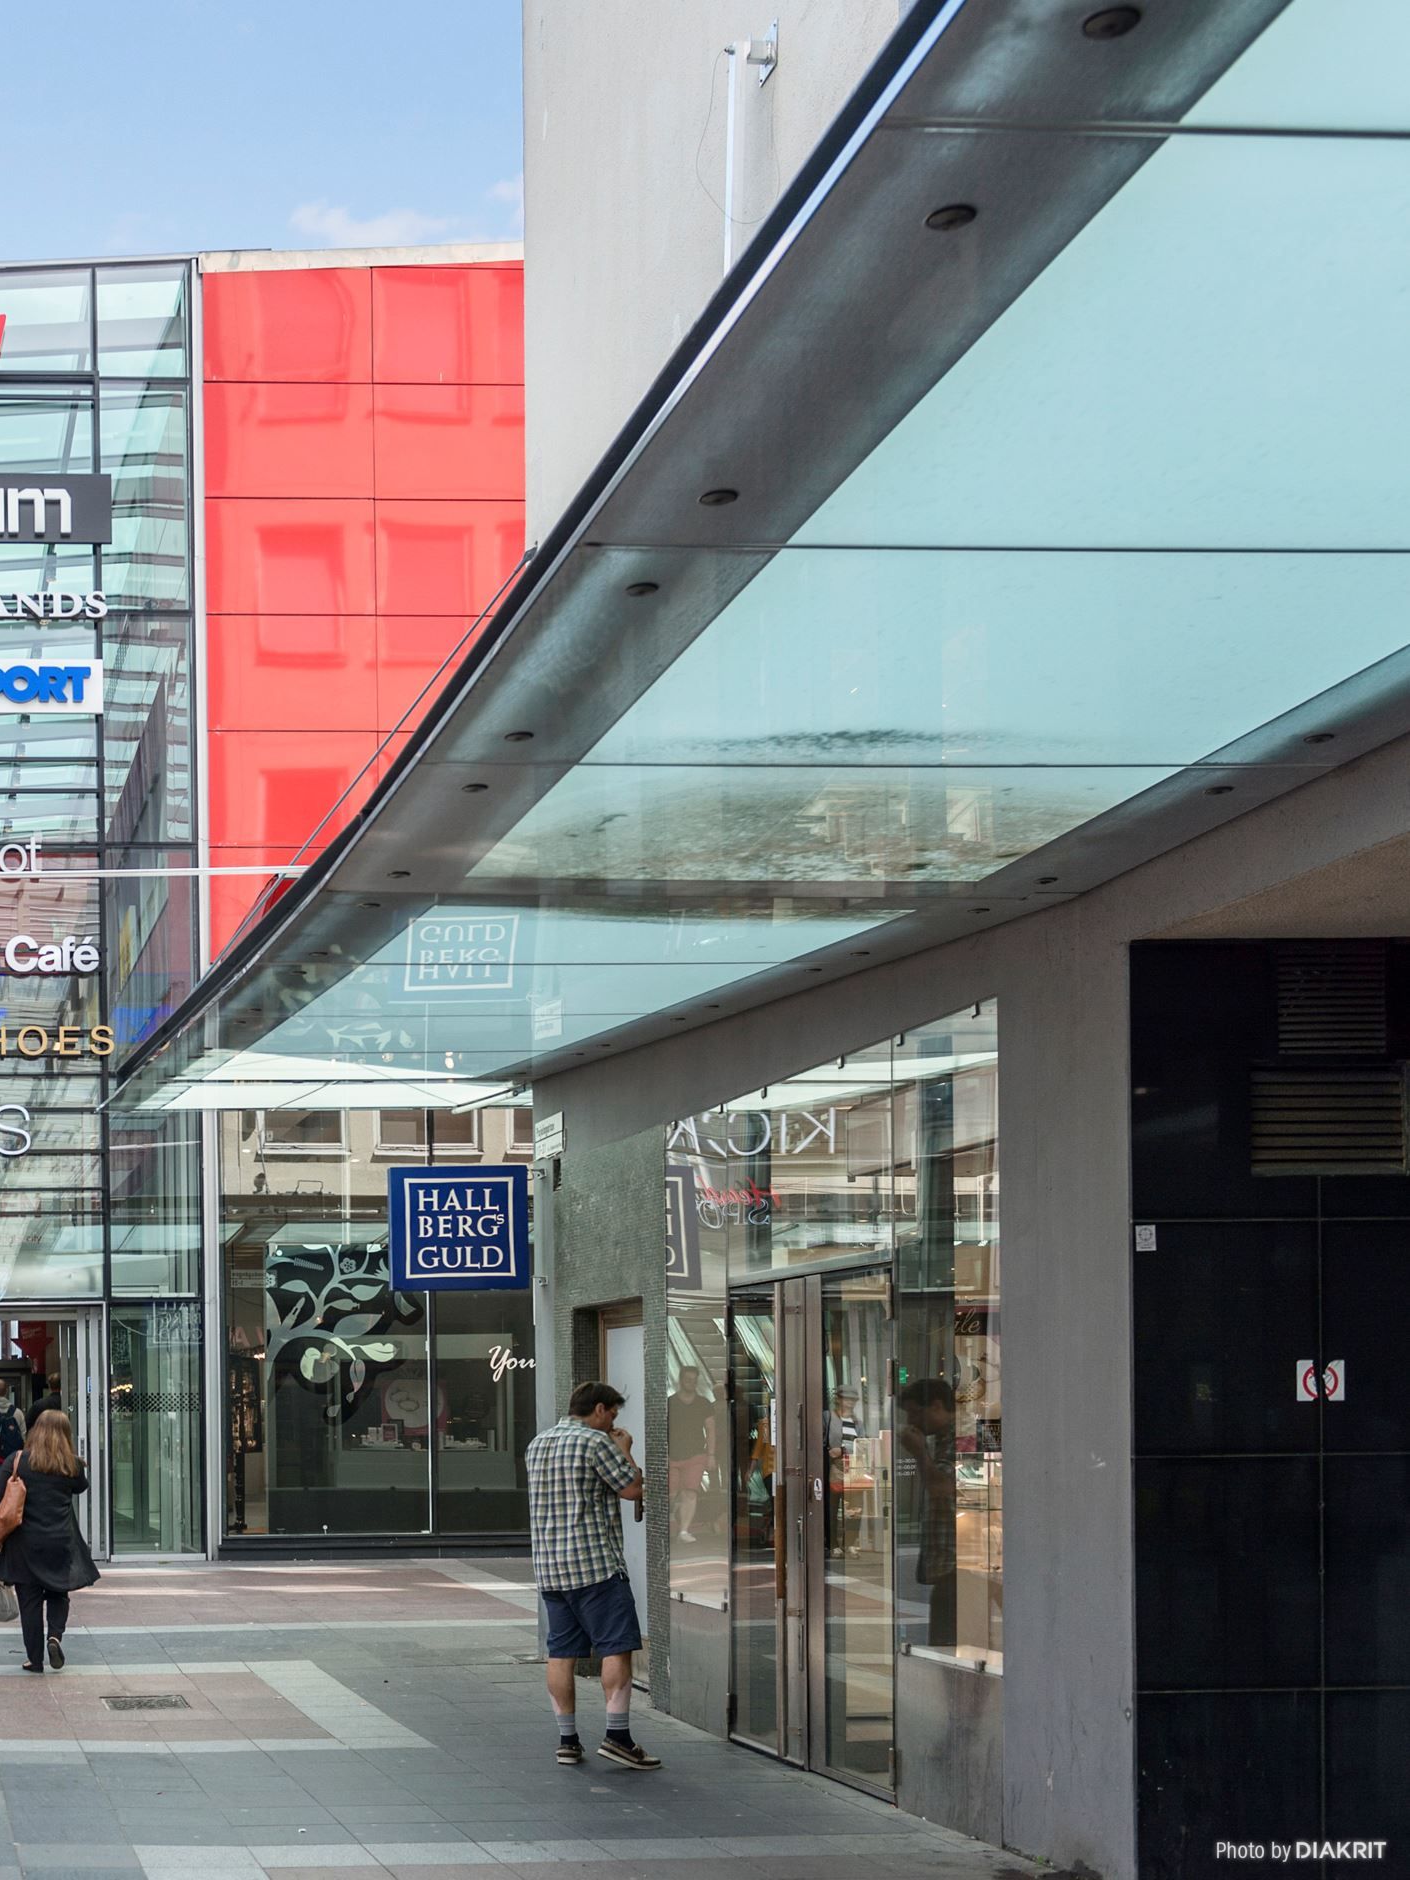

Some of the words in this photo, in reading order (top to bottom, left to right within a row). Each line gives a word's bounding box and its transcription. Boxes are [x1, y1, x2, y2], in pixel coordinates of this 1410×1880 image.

[4, 935, 100, 973] Café
[417, 1187, 500, 1213] HALL
[417, 1245, 505, 1270] GULD
